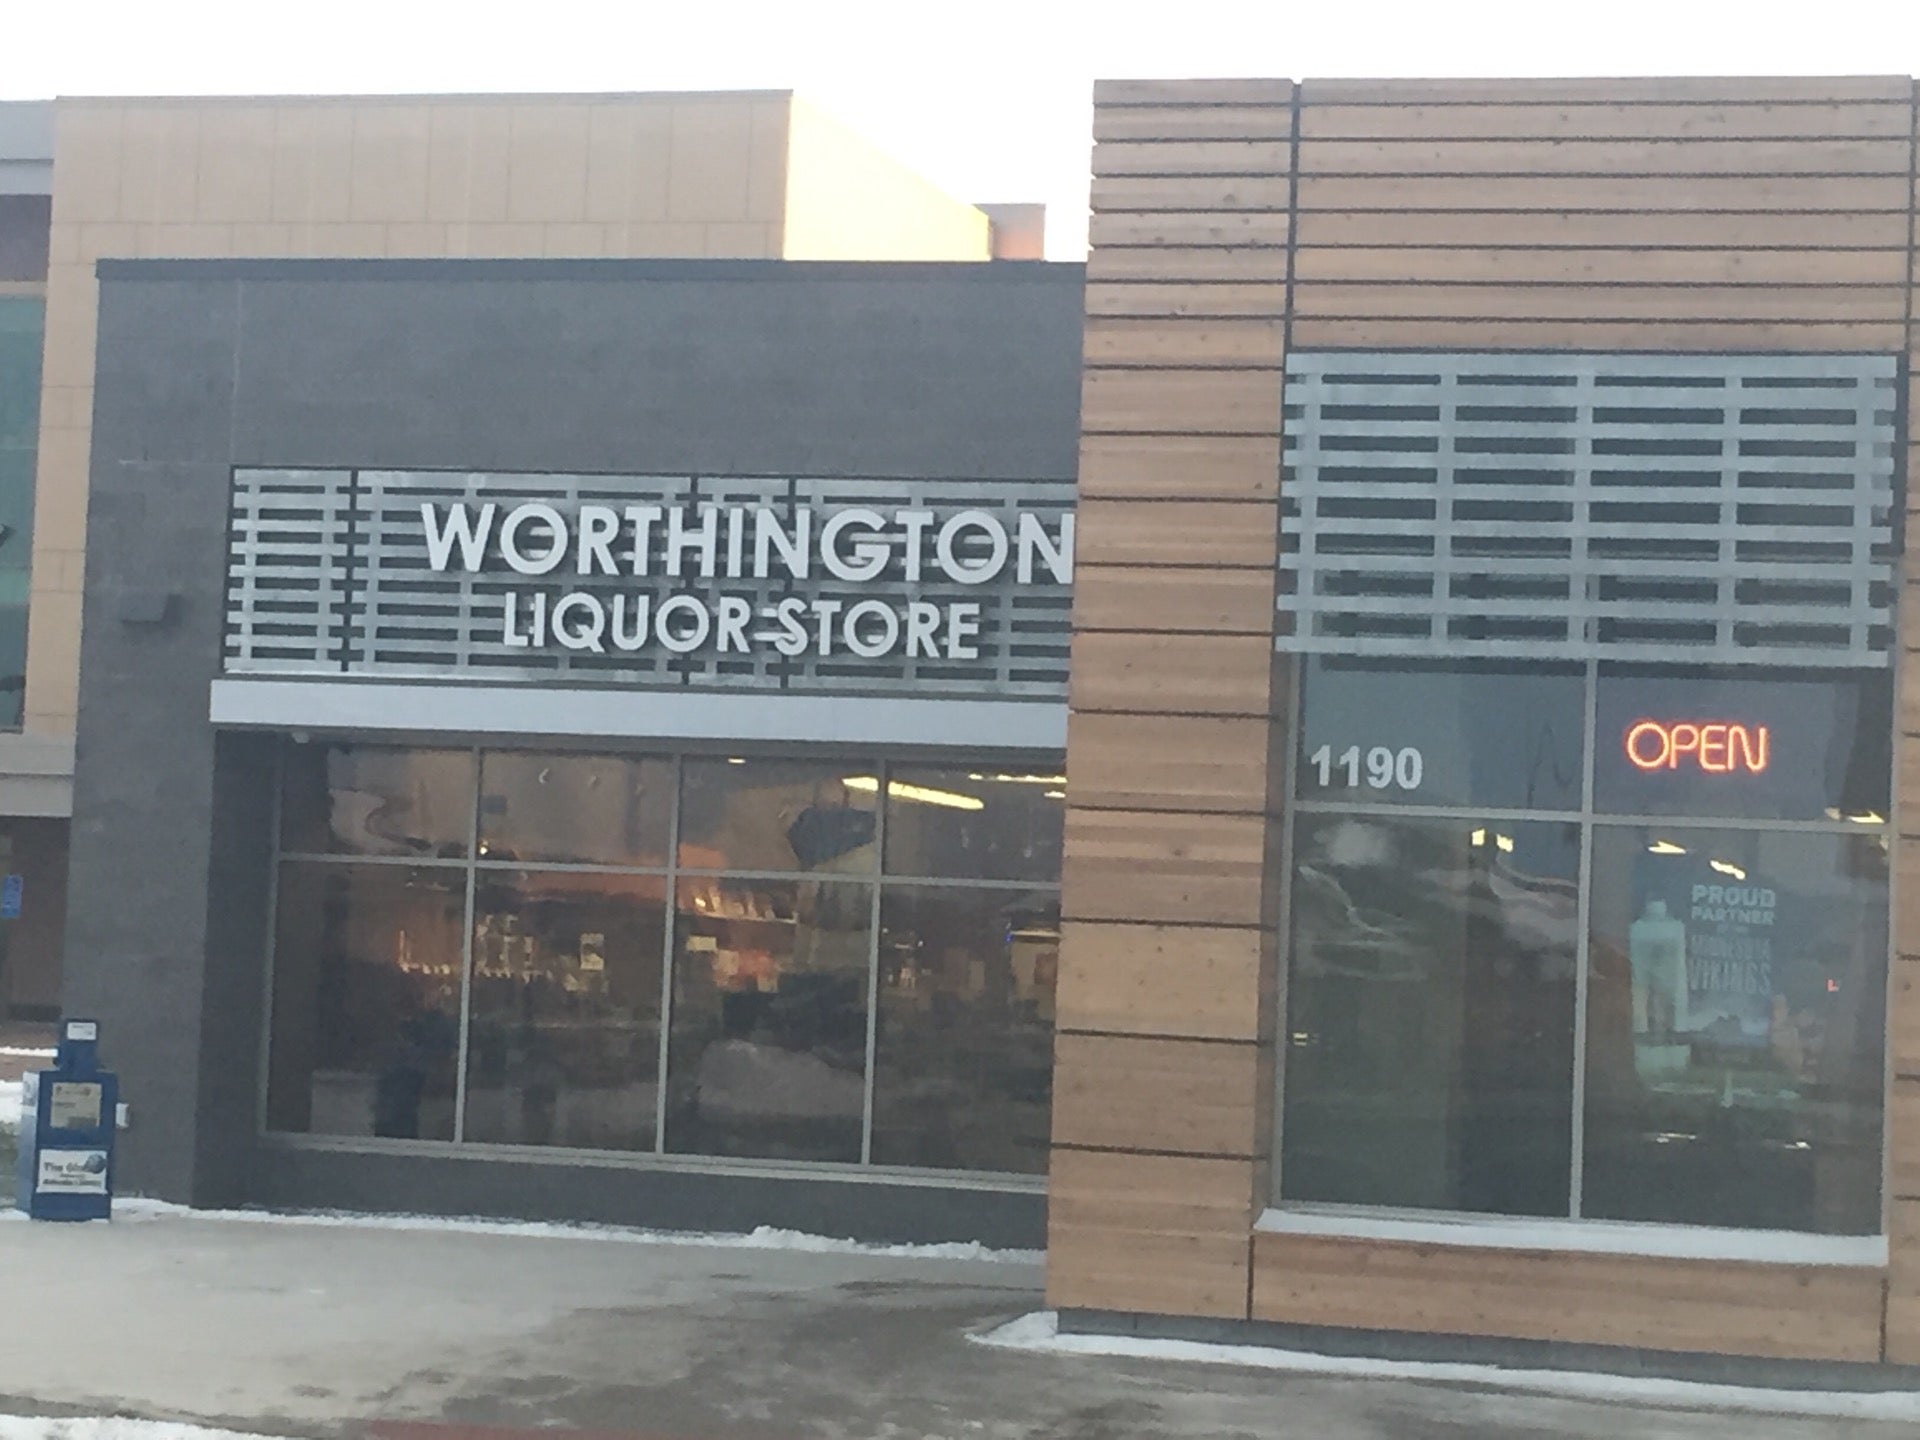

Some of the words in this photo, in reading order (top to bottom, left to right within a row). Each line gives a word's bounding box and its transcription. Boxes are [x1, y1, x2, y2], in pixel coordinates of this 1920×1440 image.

[420, 502, 1075, 585] WORTHINGTON
[503, 591, 751, 654] LIQUOR
[774, 599, 981, 660] STORE
[1310, 744, 1423, 790] 1190
[1625, 720, 1769, 774] OPEN
[1690, 884, 1776, 908] PROUD
[1690, 906, 1775, 926] PARTNER
[1688, 959, 1772, 995] VIKINGS
